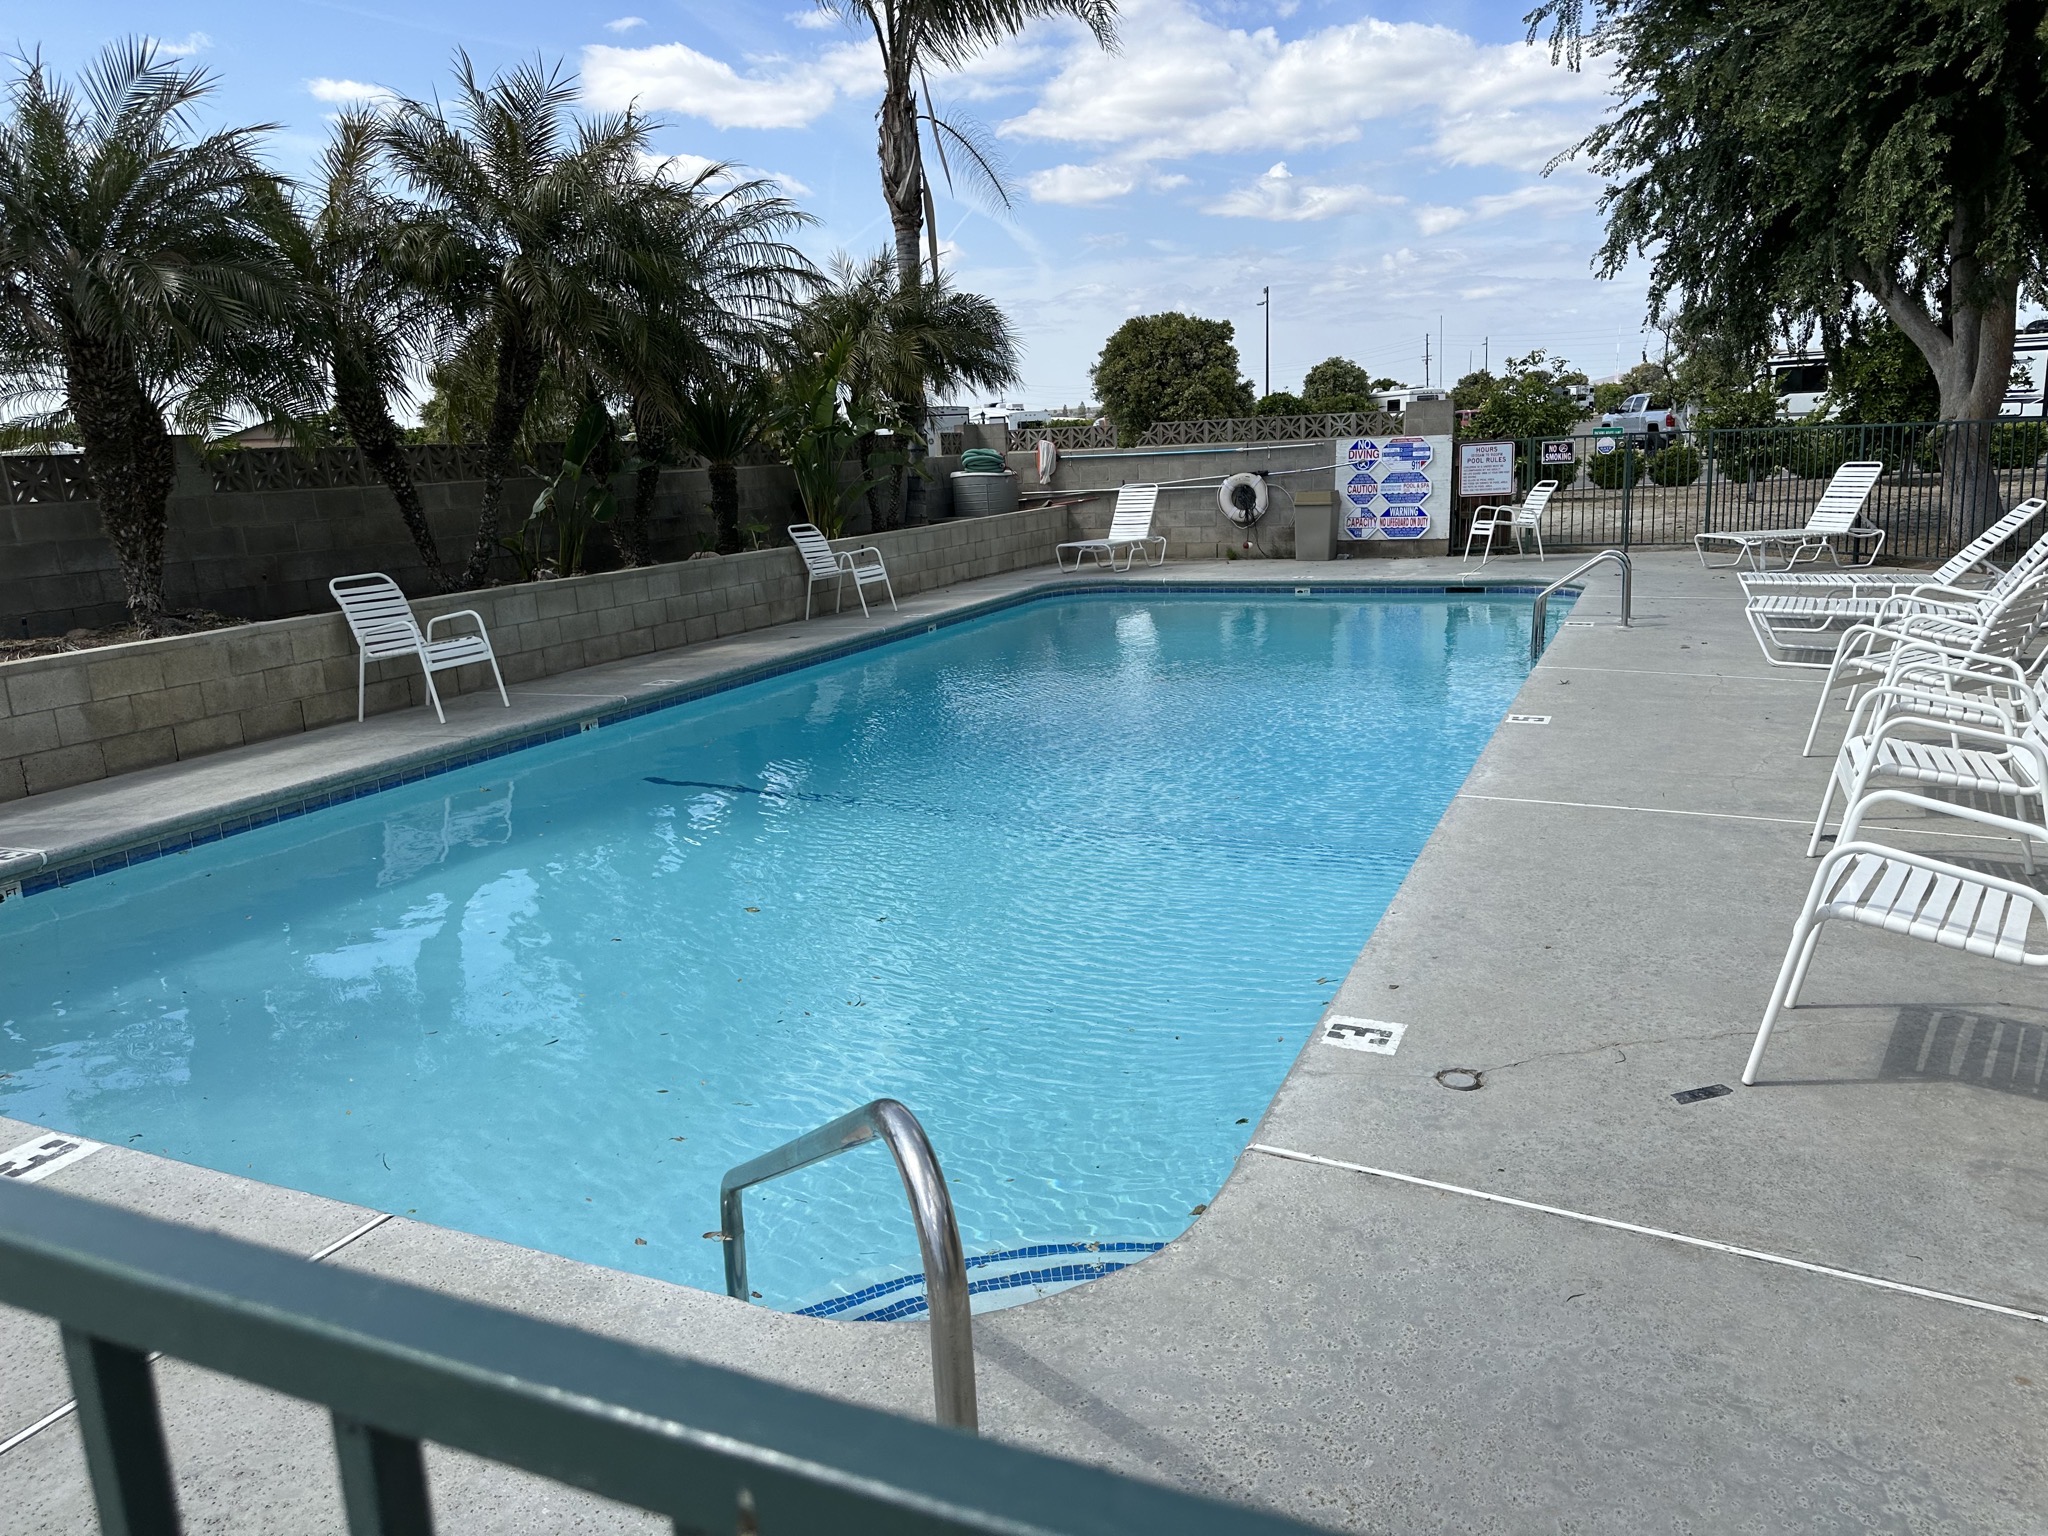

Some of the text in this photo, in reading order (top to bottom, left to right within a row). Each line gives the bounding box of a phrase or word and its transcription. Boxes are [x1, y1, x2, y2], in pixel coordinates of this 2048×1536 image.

[1358, 440, 1370, 449] NO
[1349, 450, 1379, 459] DIVING
[1545, 452, 1571, 461] SMOKING
[1412, 461, 1420, 470] 911
[1347, 485, 1377, 494] CAUTION
[1390, 506, 1418, 516] WARNING
[1347, 518, 1377, 527] CAPACITY
[1380, 517, 1428, 526] NO LIFEGUARD ON DUTY
[6, 887, 17, 897] FT
